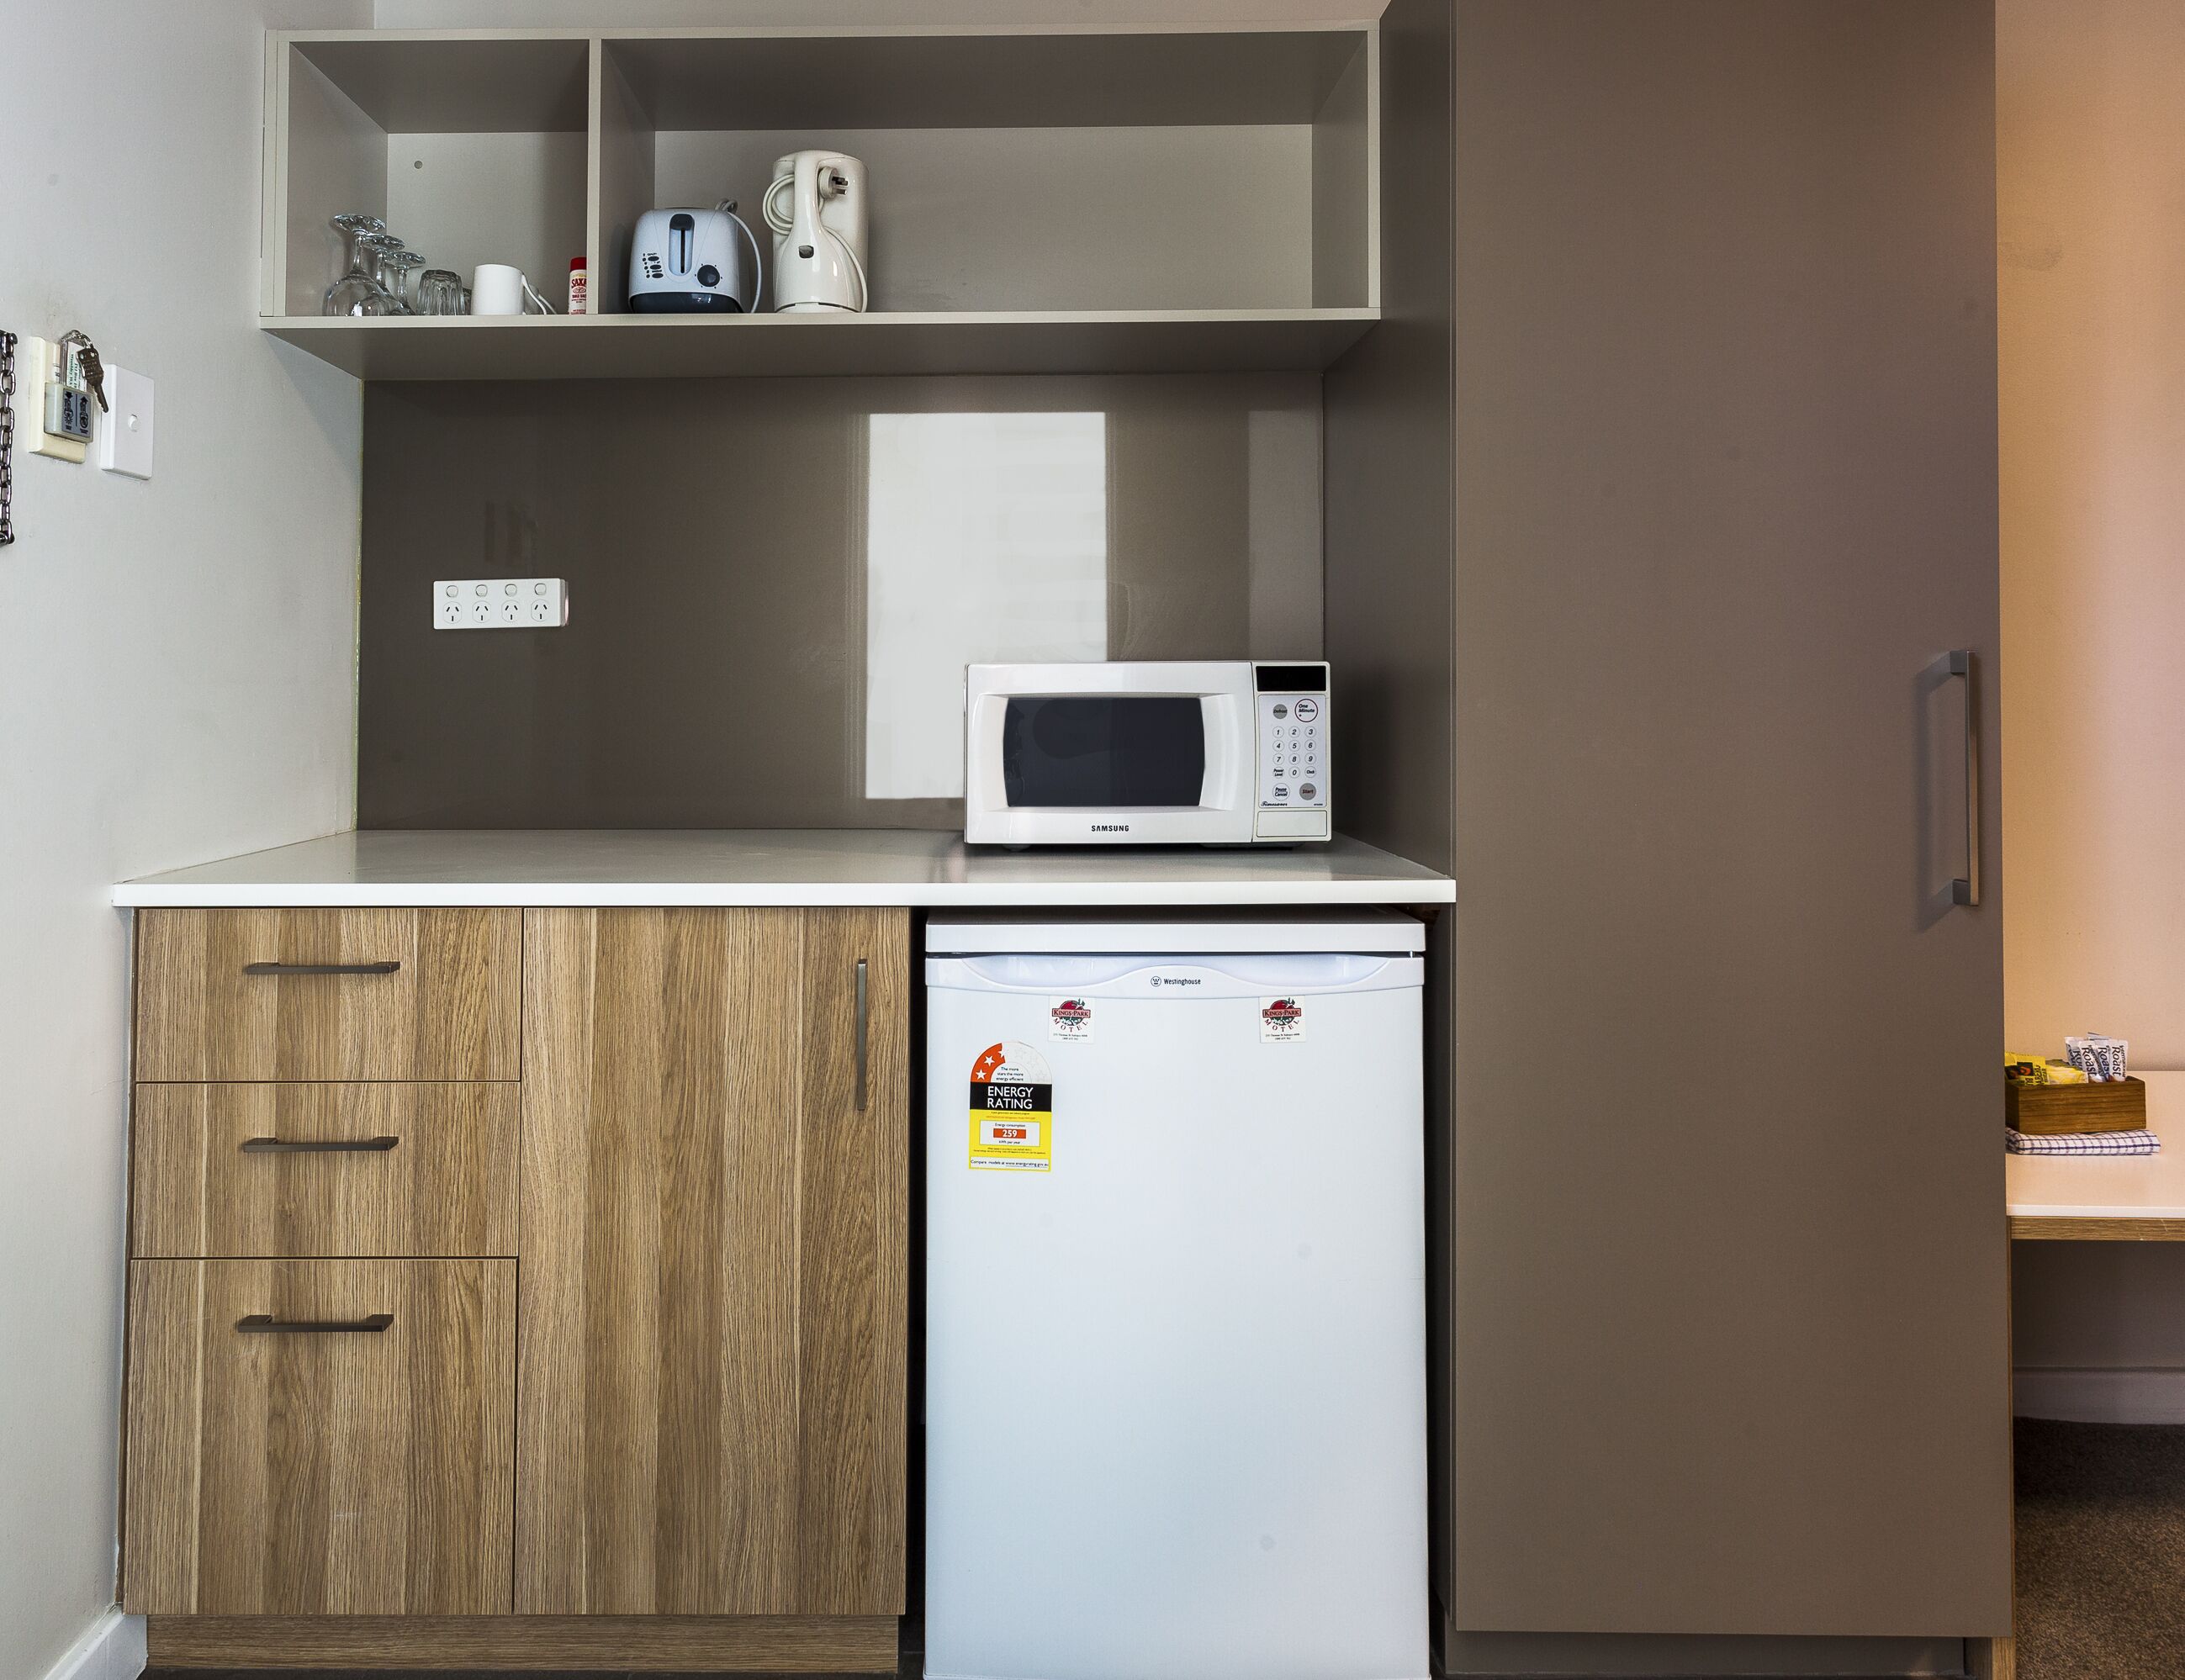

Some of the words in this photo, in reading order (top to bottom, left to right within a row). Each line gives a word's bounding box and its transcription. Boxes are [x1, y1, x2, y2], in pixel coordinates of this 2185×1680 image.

[1163, 978, 1201, 986] Westinghouse
[1054, 1018, 1088, 1033] MOTEL
[1264, 1018, 1299, 1033] MOTEL
[2082, 1048, 2098, 1076] Roast
[2112, 1046, 2121, 1076] Roast
[987, 1086, 1034, 1097] ENERGY
[987, 1097, 1033, 1109] RATING
[1002, 1129, 1018, 1138] 259
